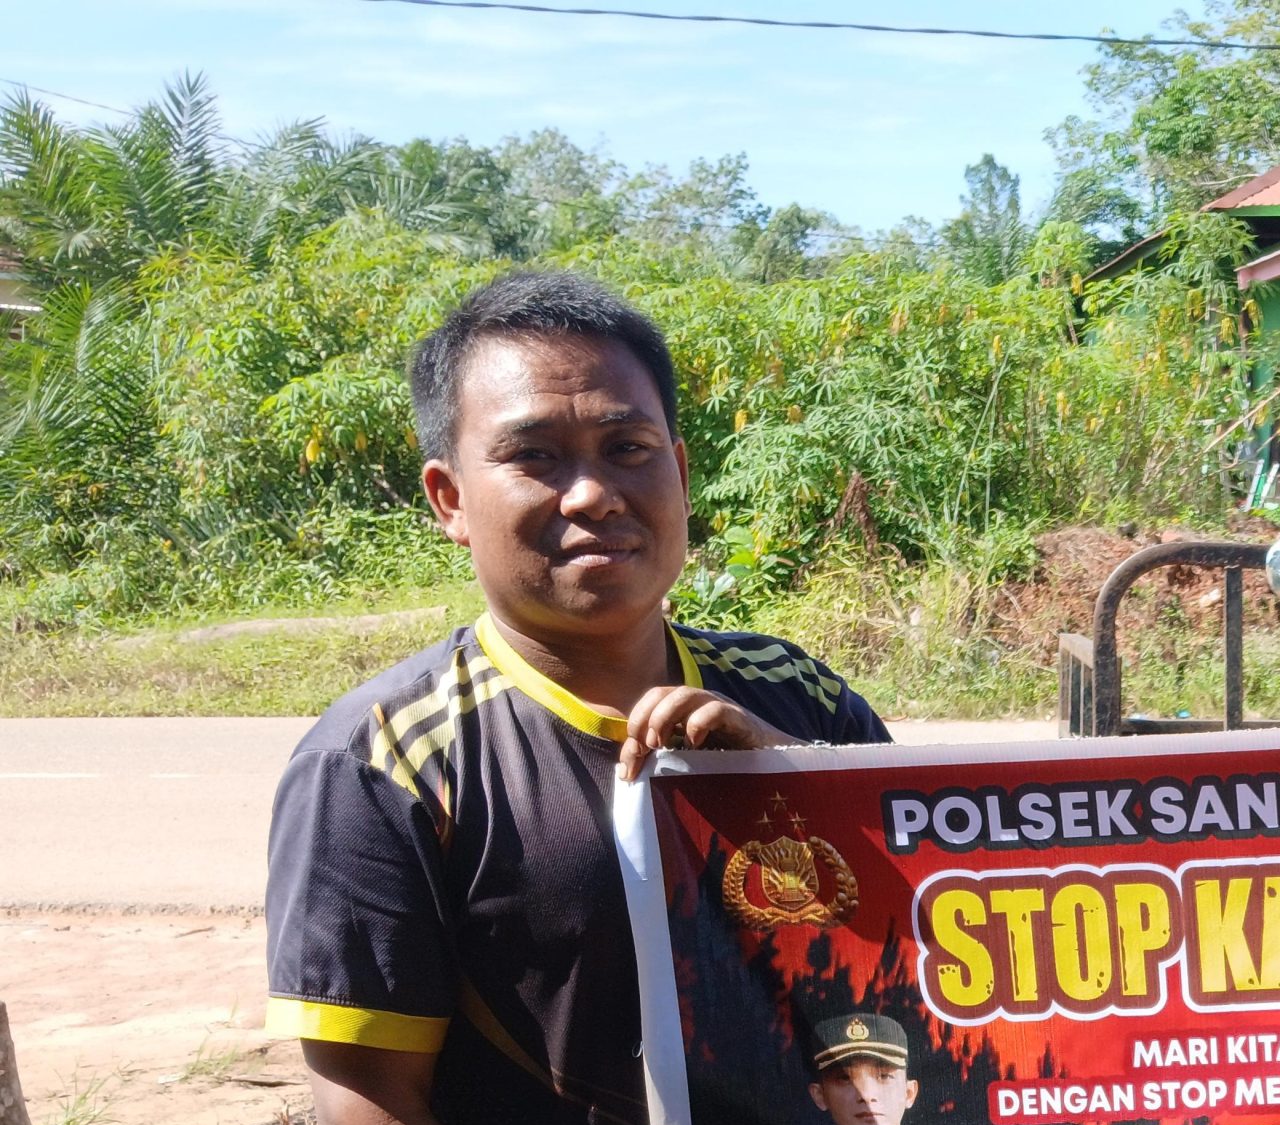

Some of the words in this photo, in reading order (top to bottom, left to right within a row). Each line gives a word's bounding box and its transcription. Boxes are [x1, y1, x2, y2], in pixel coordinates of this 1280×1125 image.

[891, 789, 1138, 847] POLSEK
[931, 882, 1172, 1007] STOP
[1133, 1037, 1219, 1068] MARI
[997, 1083, 1135, 1116] DENGAN
[1142, 1078, 1227, 1110] STOP
